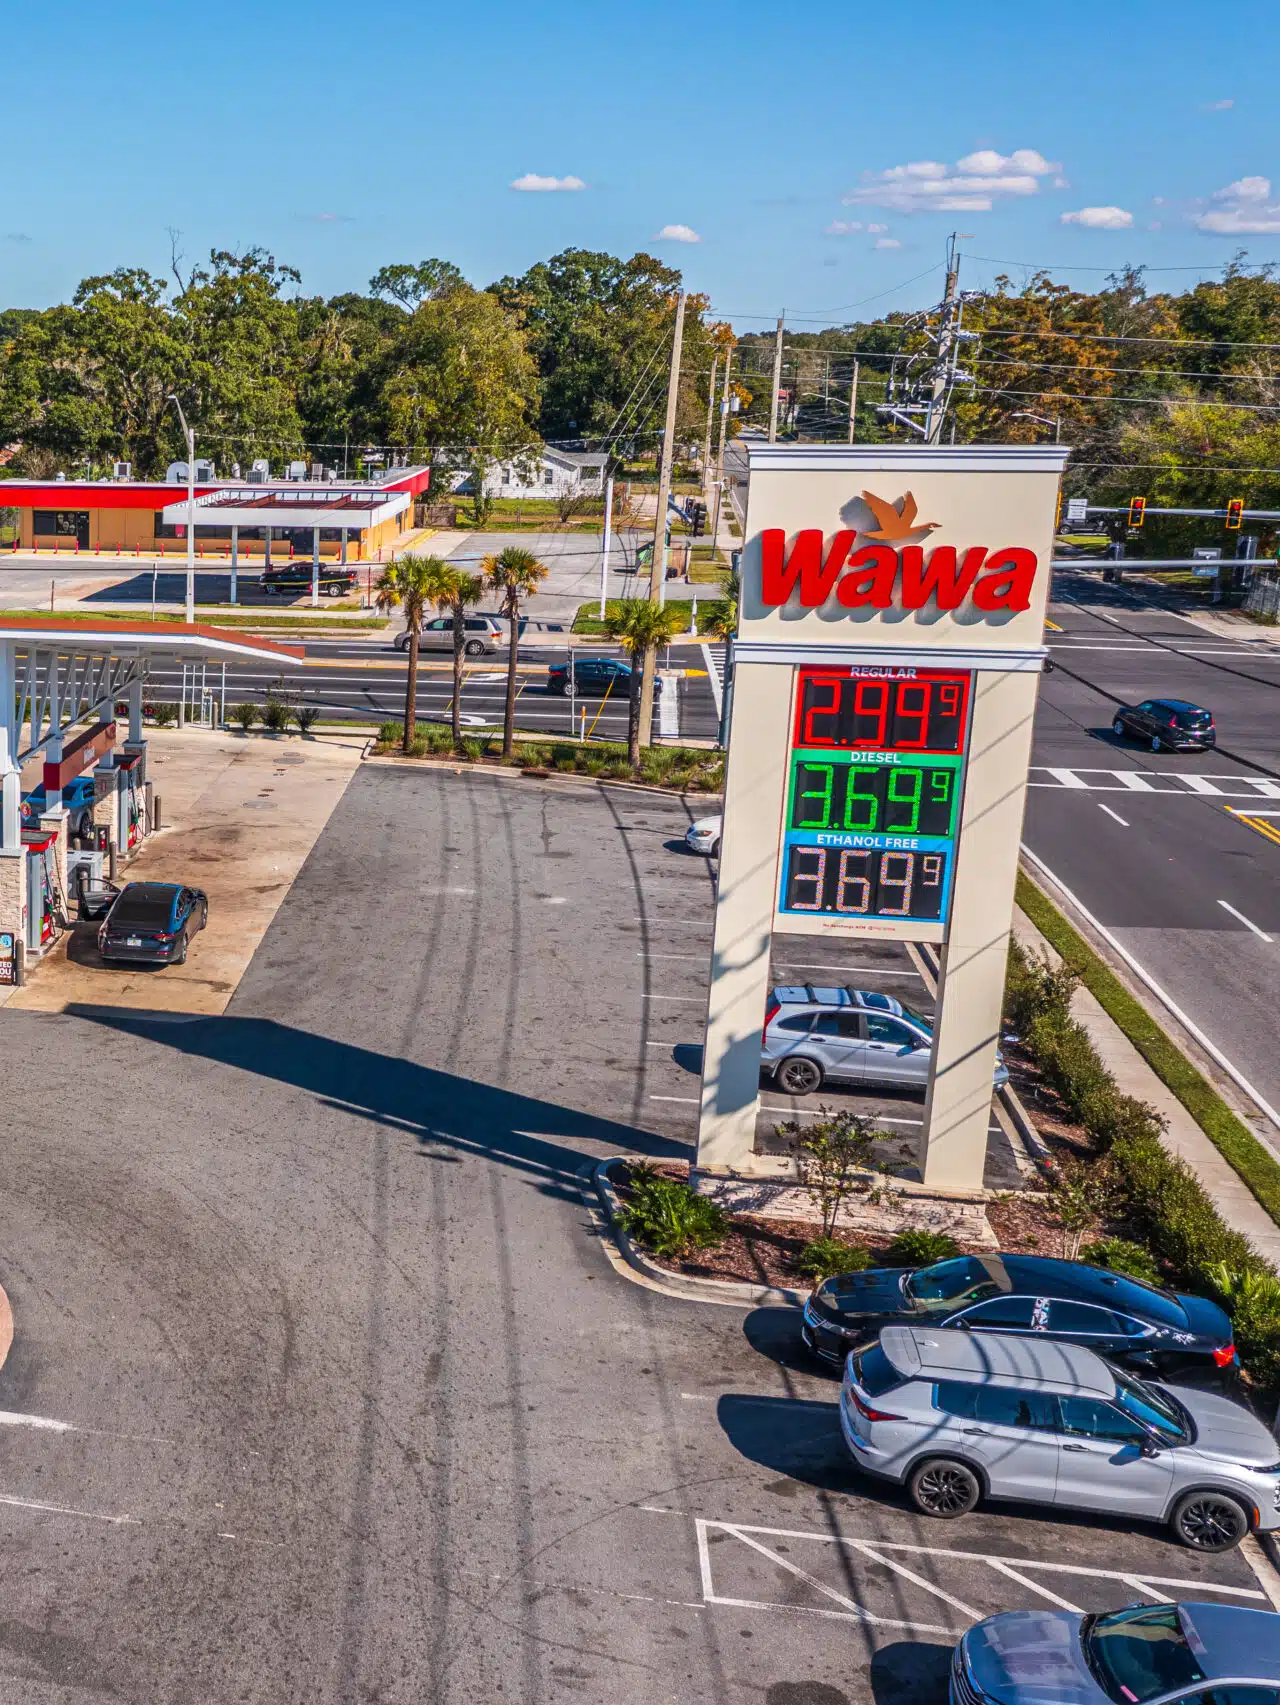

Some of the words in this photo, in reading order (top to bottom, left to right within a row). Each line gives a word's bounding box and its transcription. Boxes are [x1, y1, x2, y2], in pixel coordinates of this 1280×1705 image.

[762, 529, 1038, 611] Wawa
[850, 666, 917, 679] REGULAR
[850, 751, 901, 764] DIESEL
[816, 834, 881, 847] ETHANOL
[885, 837, 919, 849] FREE
